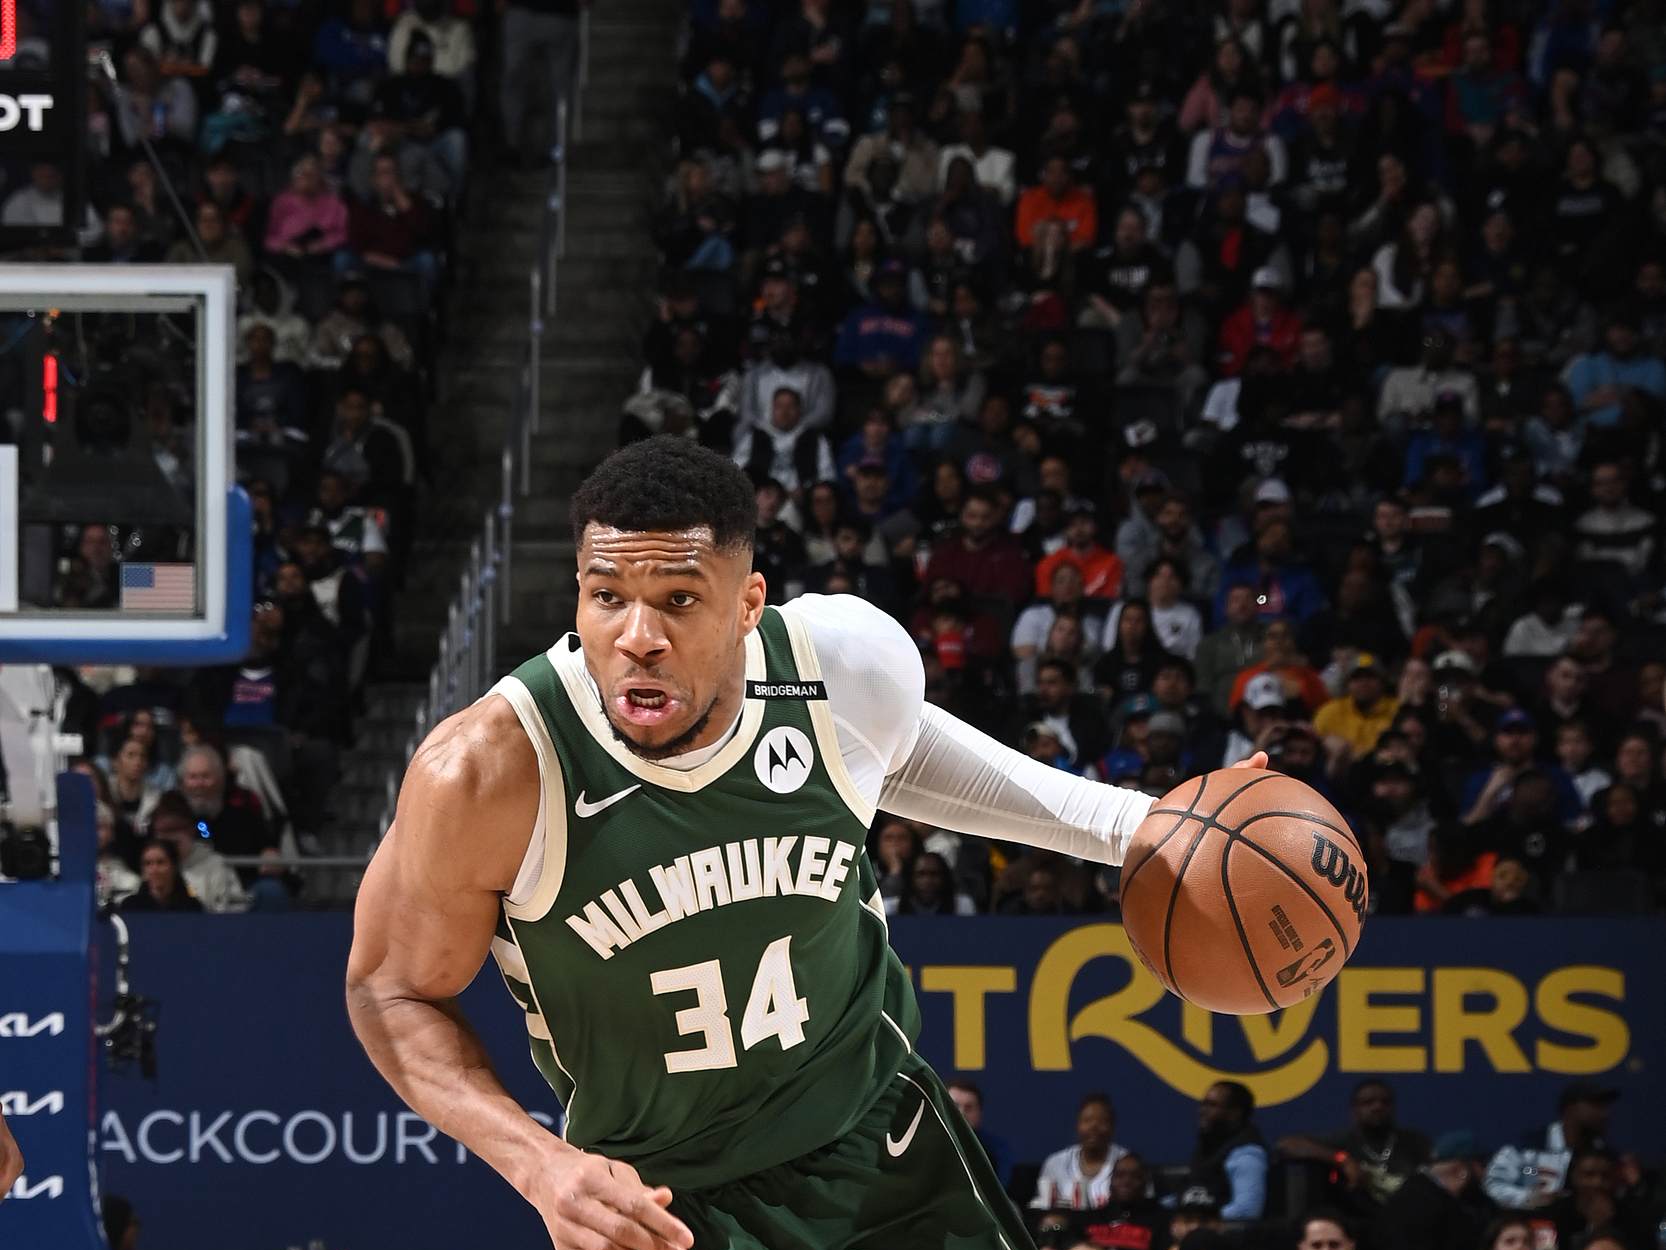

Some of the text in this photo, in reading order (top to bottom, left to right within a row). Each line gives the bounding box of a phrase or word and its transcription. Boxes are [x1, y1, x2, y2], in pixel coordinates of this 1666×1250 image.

[754, 685, 818, 697] BRIDGEMAN
[565, 835, 856, 960] MILWAUKEE
[650, 935, 810, 1073] 34
